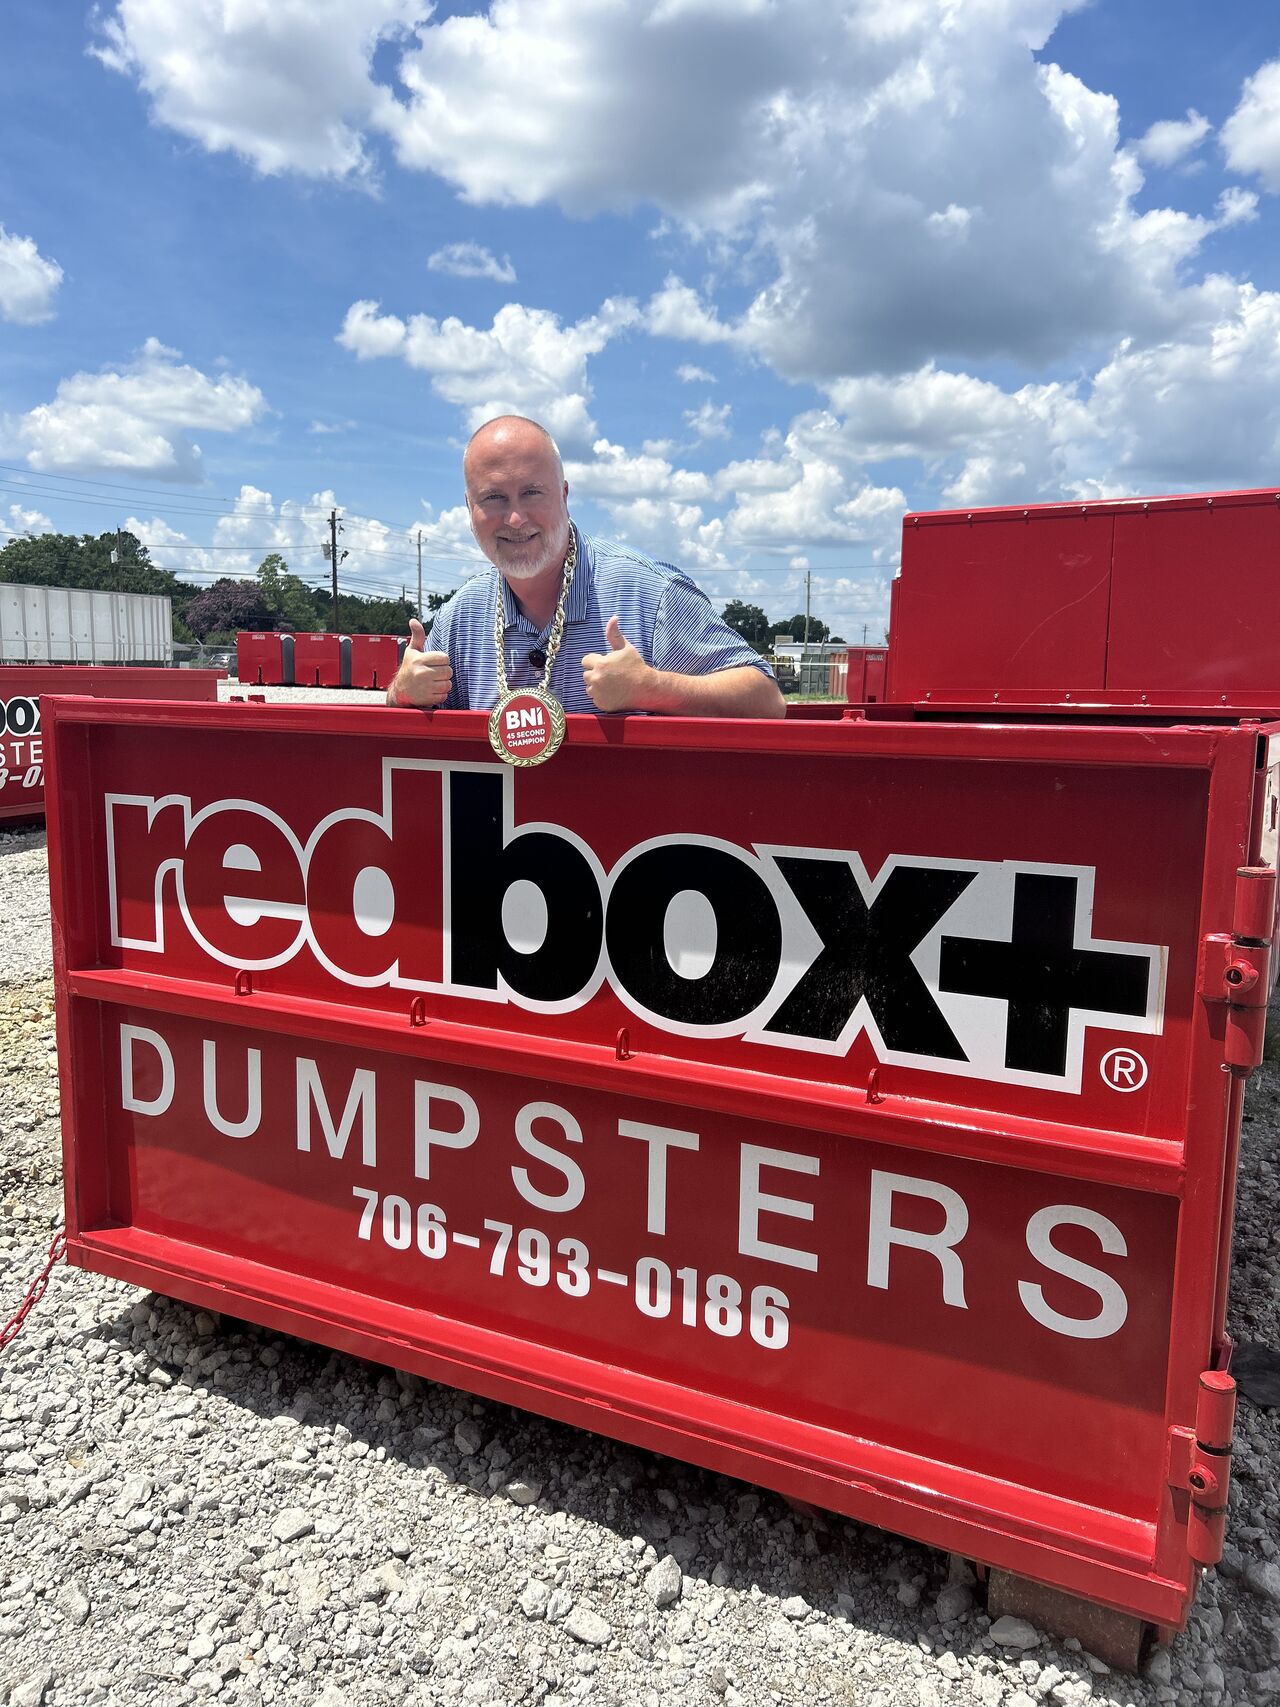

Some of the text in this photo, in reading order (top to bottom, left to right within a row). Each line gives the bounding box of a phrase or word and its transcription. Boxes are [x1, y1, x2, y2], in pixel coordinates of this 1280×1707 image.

[506, 728, 545, 740] 45 SECOND
[507, 736, 545, 748] CHAMPION
[121, 1024, 1127, 1338] DUMPSTERS
[353, 1186, 789, 1349] 706-793-0186
